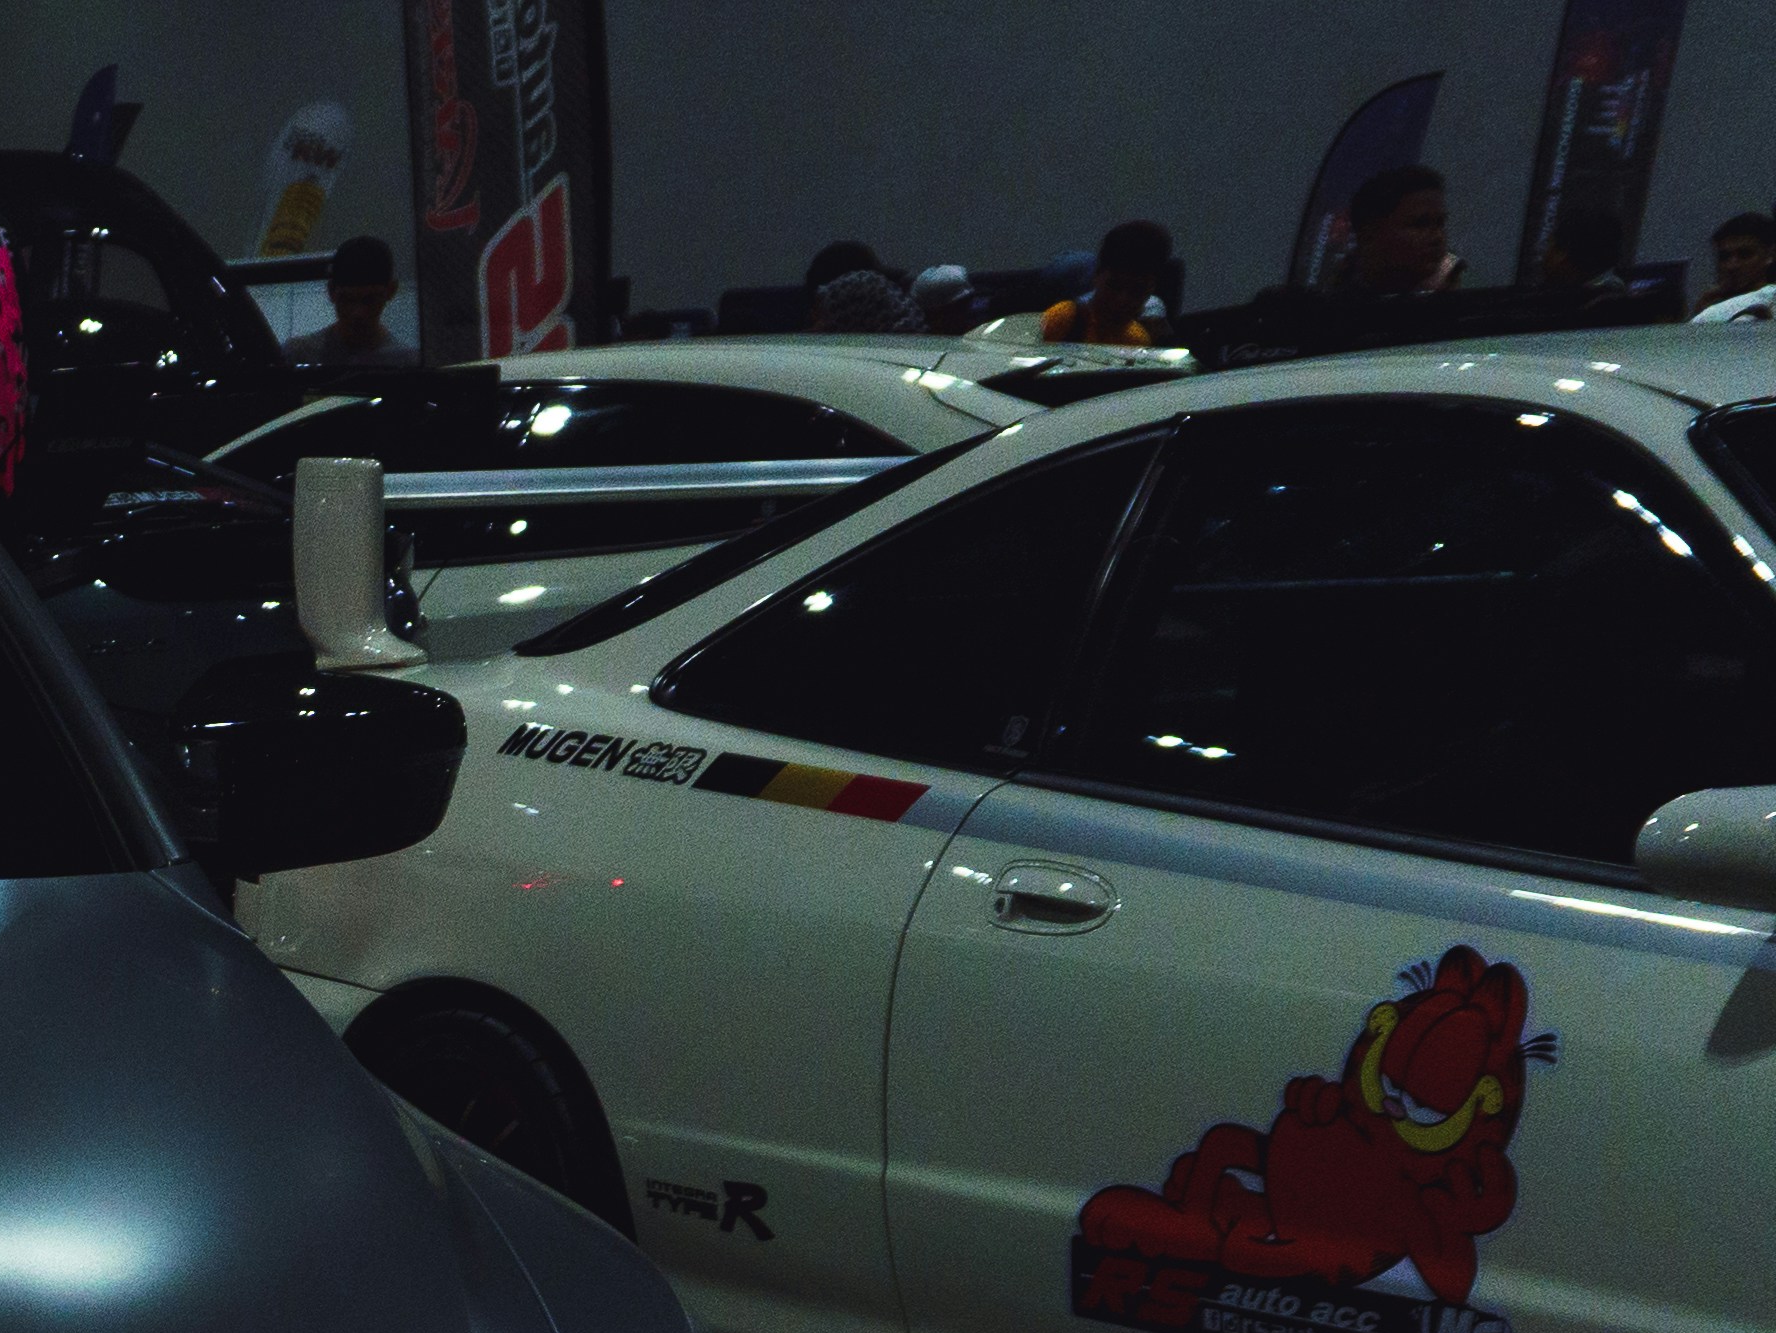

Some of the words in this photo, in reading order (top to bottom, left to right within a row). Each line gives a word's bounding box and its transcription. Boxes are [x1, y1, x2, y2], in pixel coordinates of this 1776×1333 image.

[497, 722, 639, 773] MUGEN
[719, 1180, 775, 1241] R
[1080, 1256, 1209, 1327] RS
[1219, 1283, 1302, 1318] auto
[1309, 1301, 1381, 1333] acc
